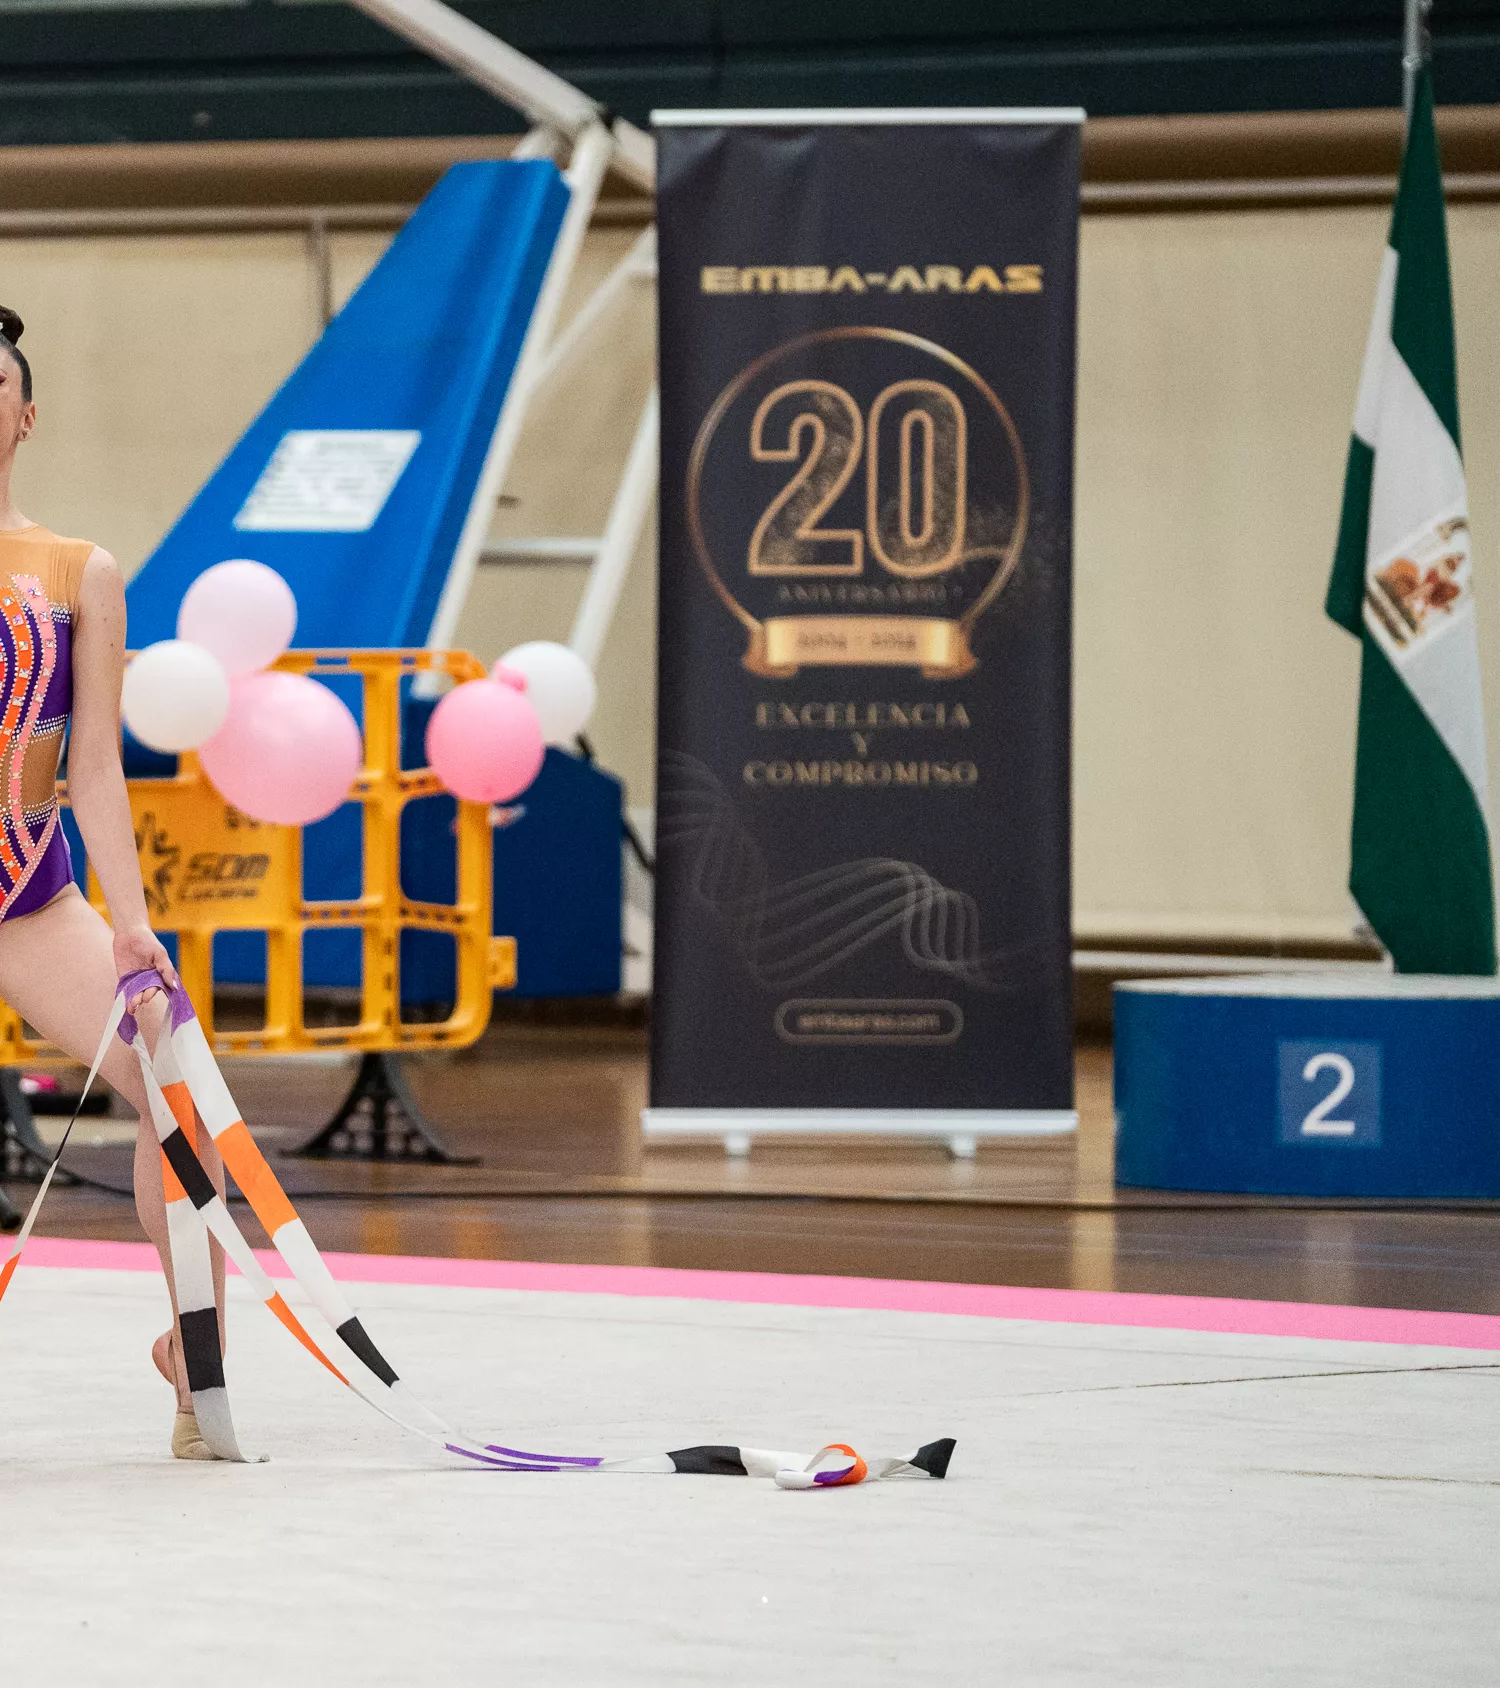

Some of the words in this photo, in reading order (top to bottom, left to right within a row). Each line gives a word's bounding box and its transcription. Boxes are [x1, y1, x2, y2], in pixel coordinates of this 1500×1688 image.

[700, 265, 1043, 294] EMBA-ARAS
[749, 379, 966, 578] 20
[755, 702, 972, 730] EXCELENCIA
[852, 733, 872, 759] Y
[743, 760, 979, 788] COMPROMISO
[1300, 1052, 1357, 1136] 2
